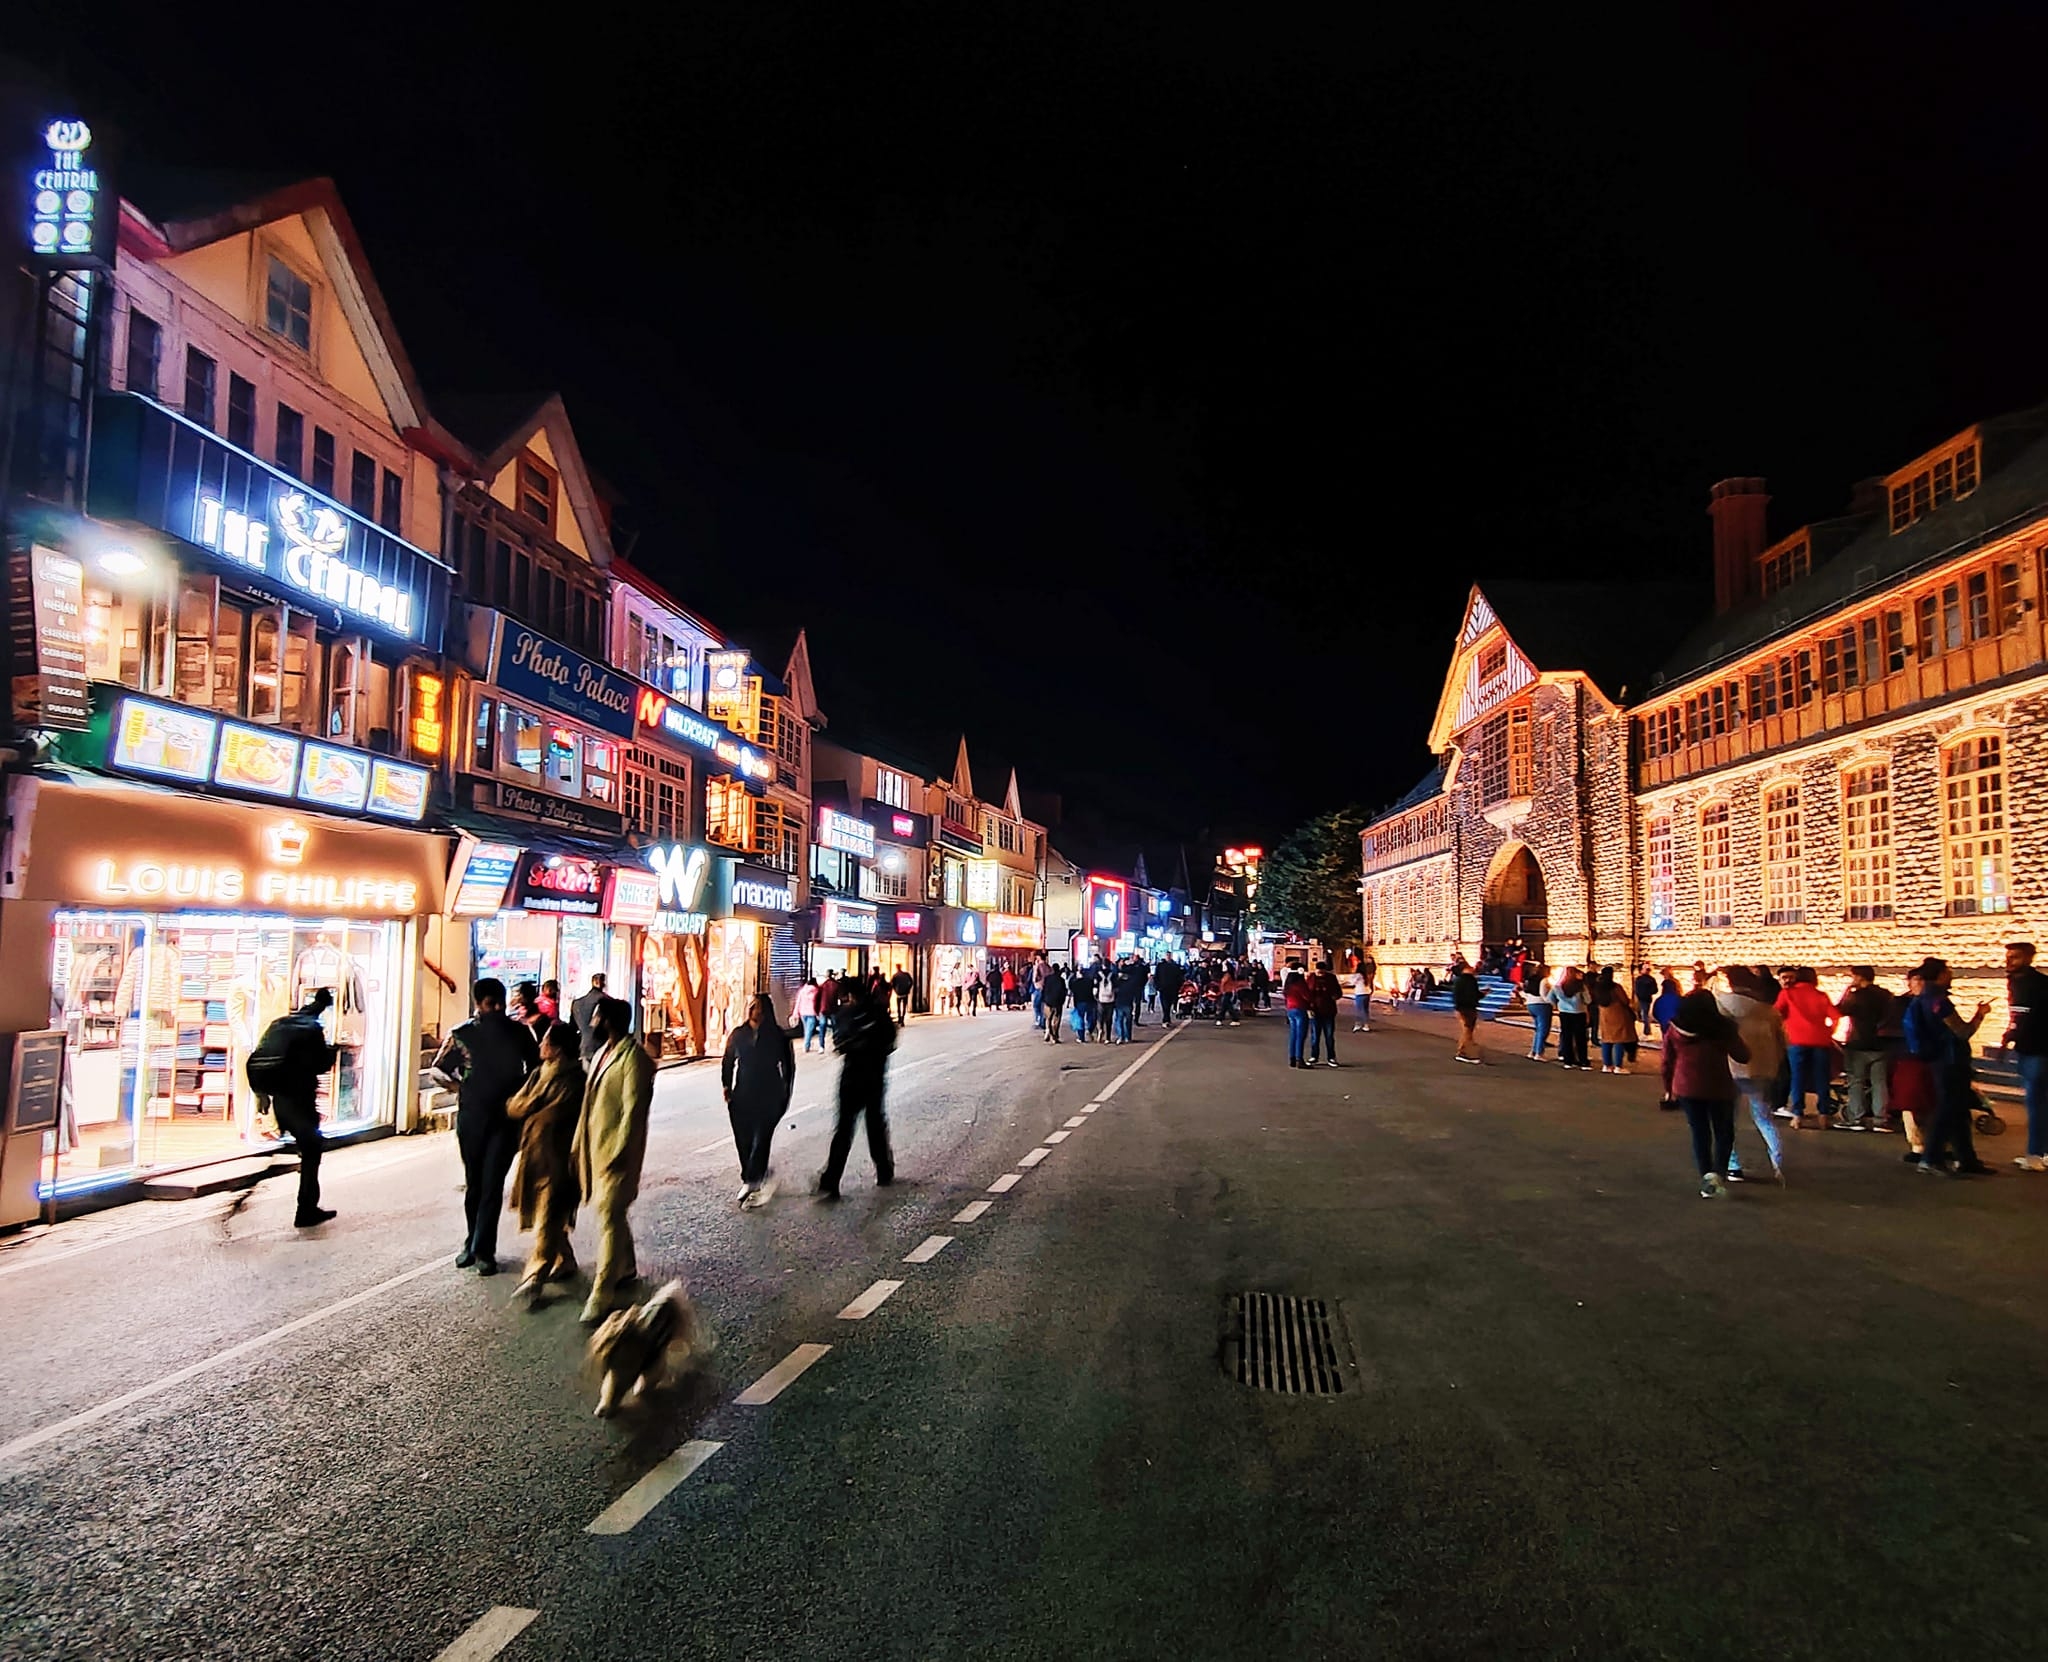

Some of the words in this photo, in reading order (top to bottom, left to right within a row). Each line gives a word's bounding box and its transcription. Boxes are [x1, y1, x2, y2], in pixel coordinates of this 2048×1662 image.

[54, 151, 82, 169] THE
[35, 169, 99, 191] CENTRAL
[42, 599, 79, 616] INDIAN
[47, 685, 83, 699] PIZZAS
[511, 631, 570, 686] Photo
[573, 663, 630, 734] Palace
[47, 703, 86, 717] PASTAS
[129, 709, 145, 744] SHAKES
[503, 788, 542, 814] Photo
[545, 799, 585, 824] Palace
[100, 860, 244, 899] LOUIS
